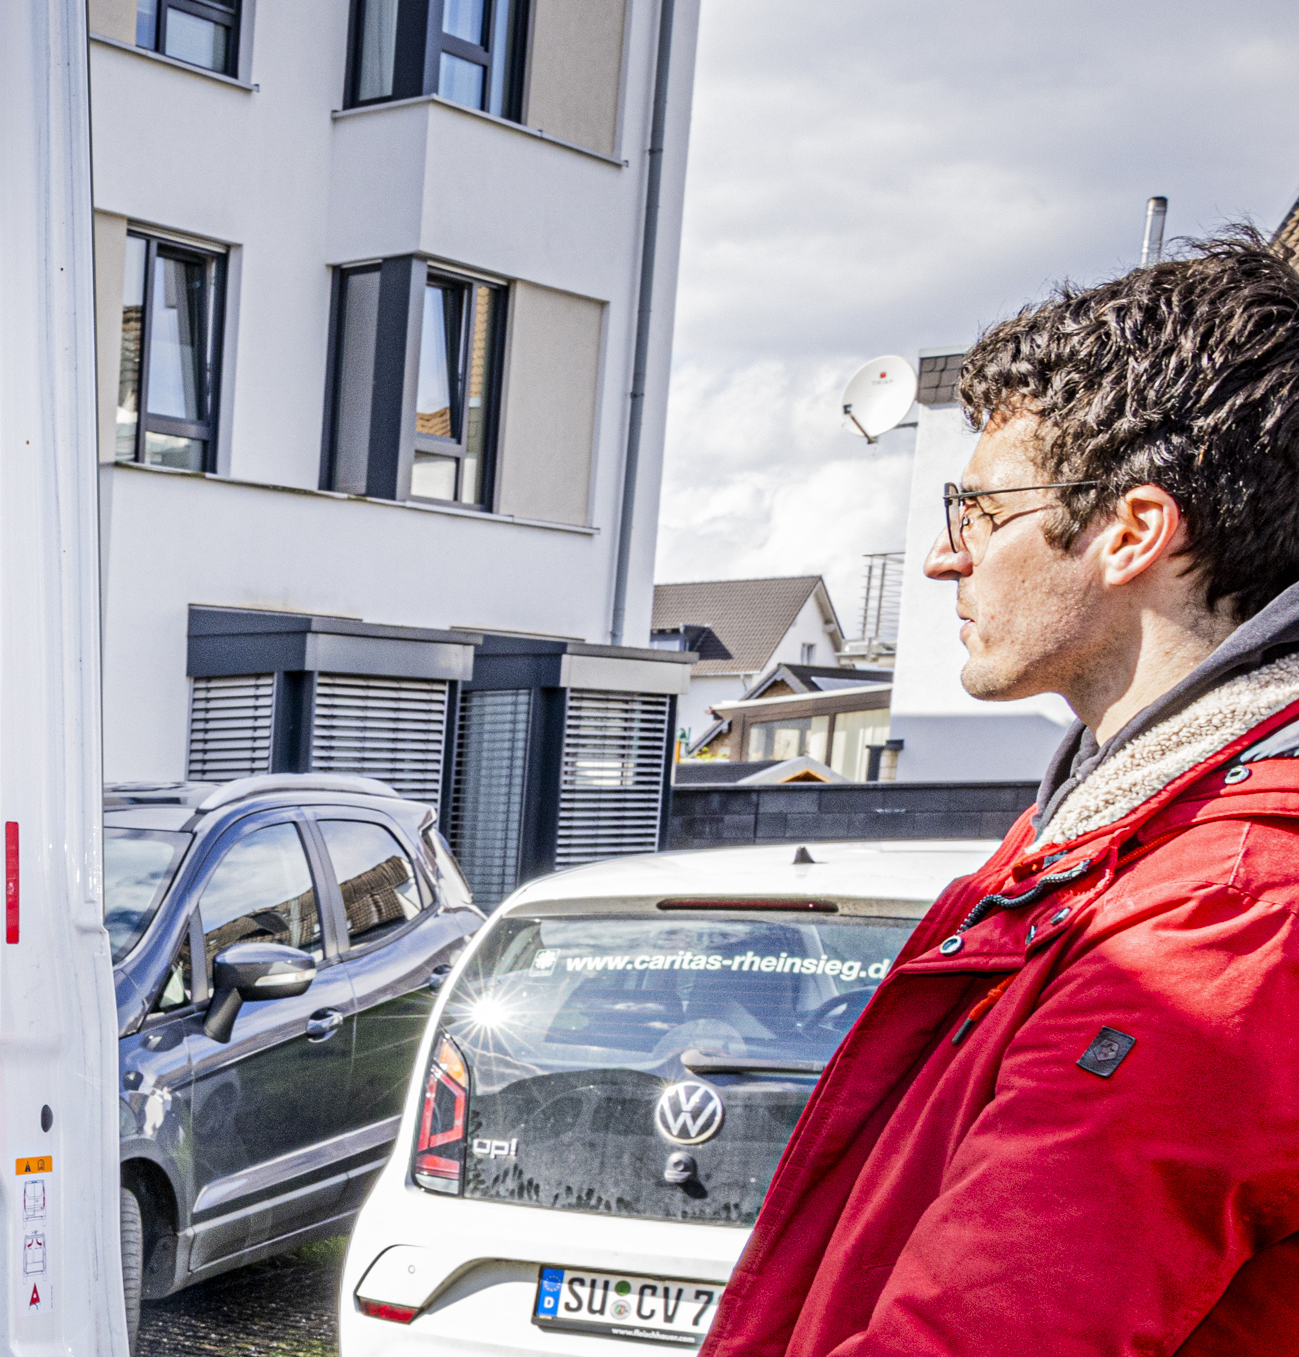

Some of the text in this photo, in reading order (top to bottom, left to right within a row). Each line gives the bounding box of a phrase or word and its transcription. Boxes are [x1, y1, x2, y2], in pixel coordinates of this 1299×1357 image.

[565, 951, 893, 981] www.caritas-rheinsieg.d
[543, 1296, 555, 1309] D
[564, 1277, 723, 1327] SU CV 7
[611, 1327, 695, 1344] www.fleischhauer.com
